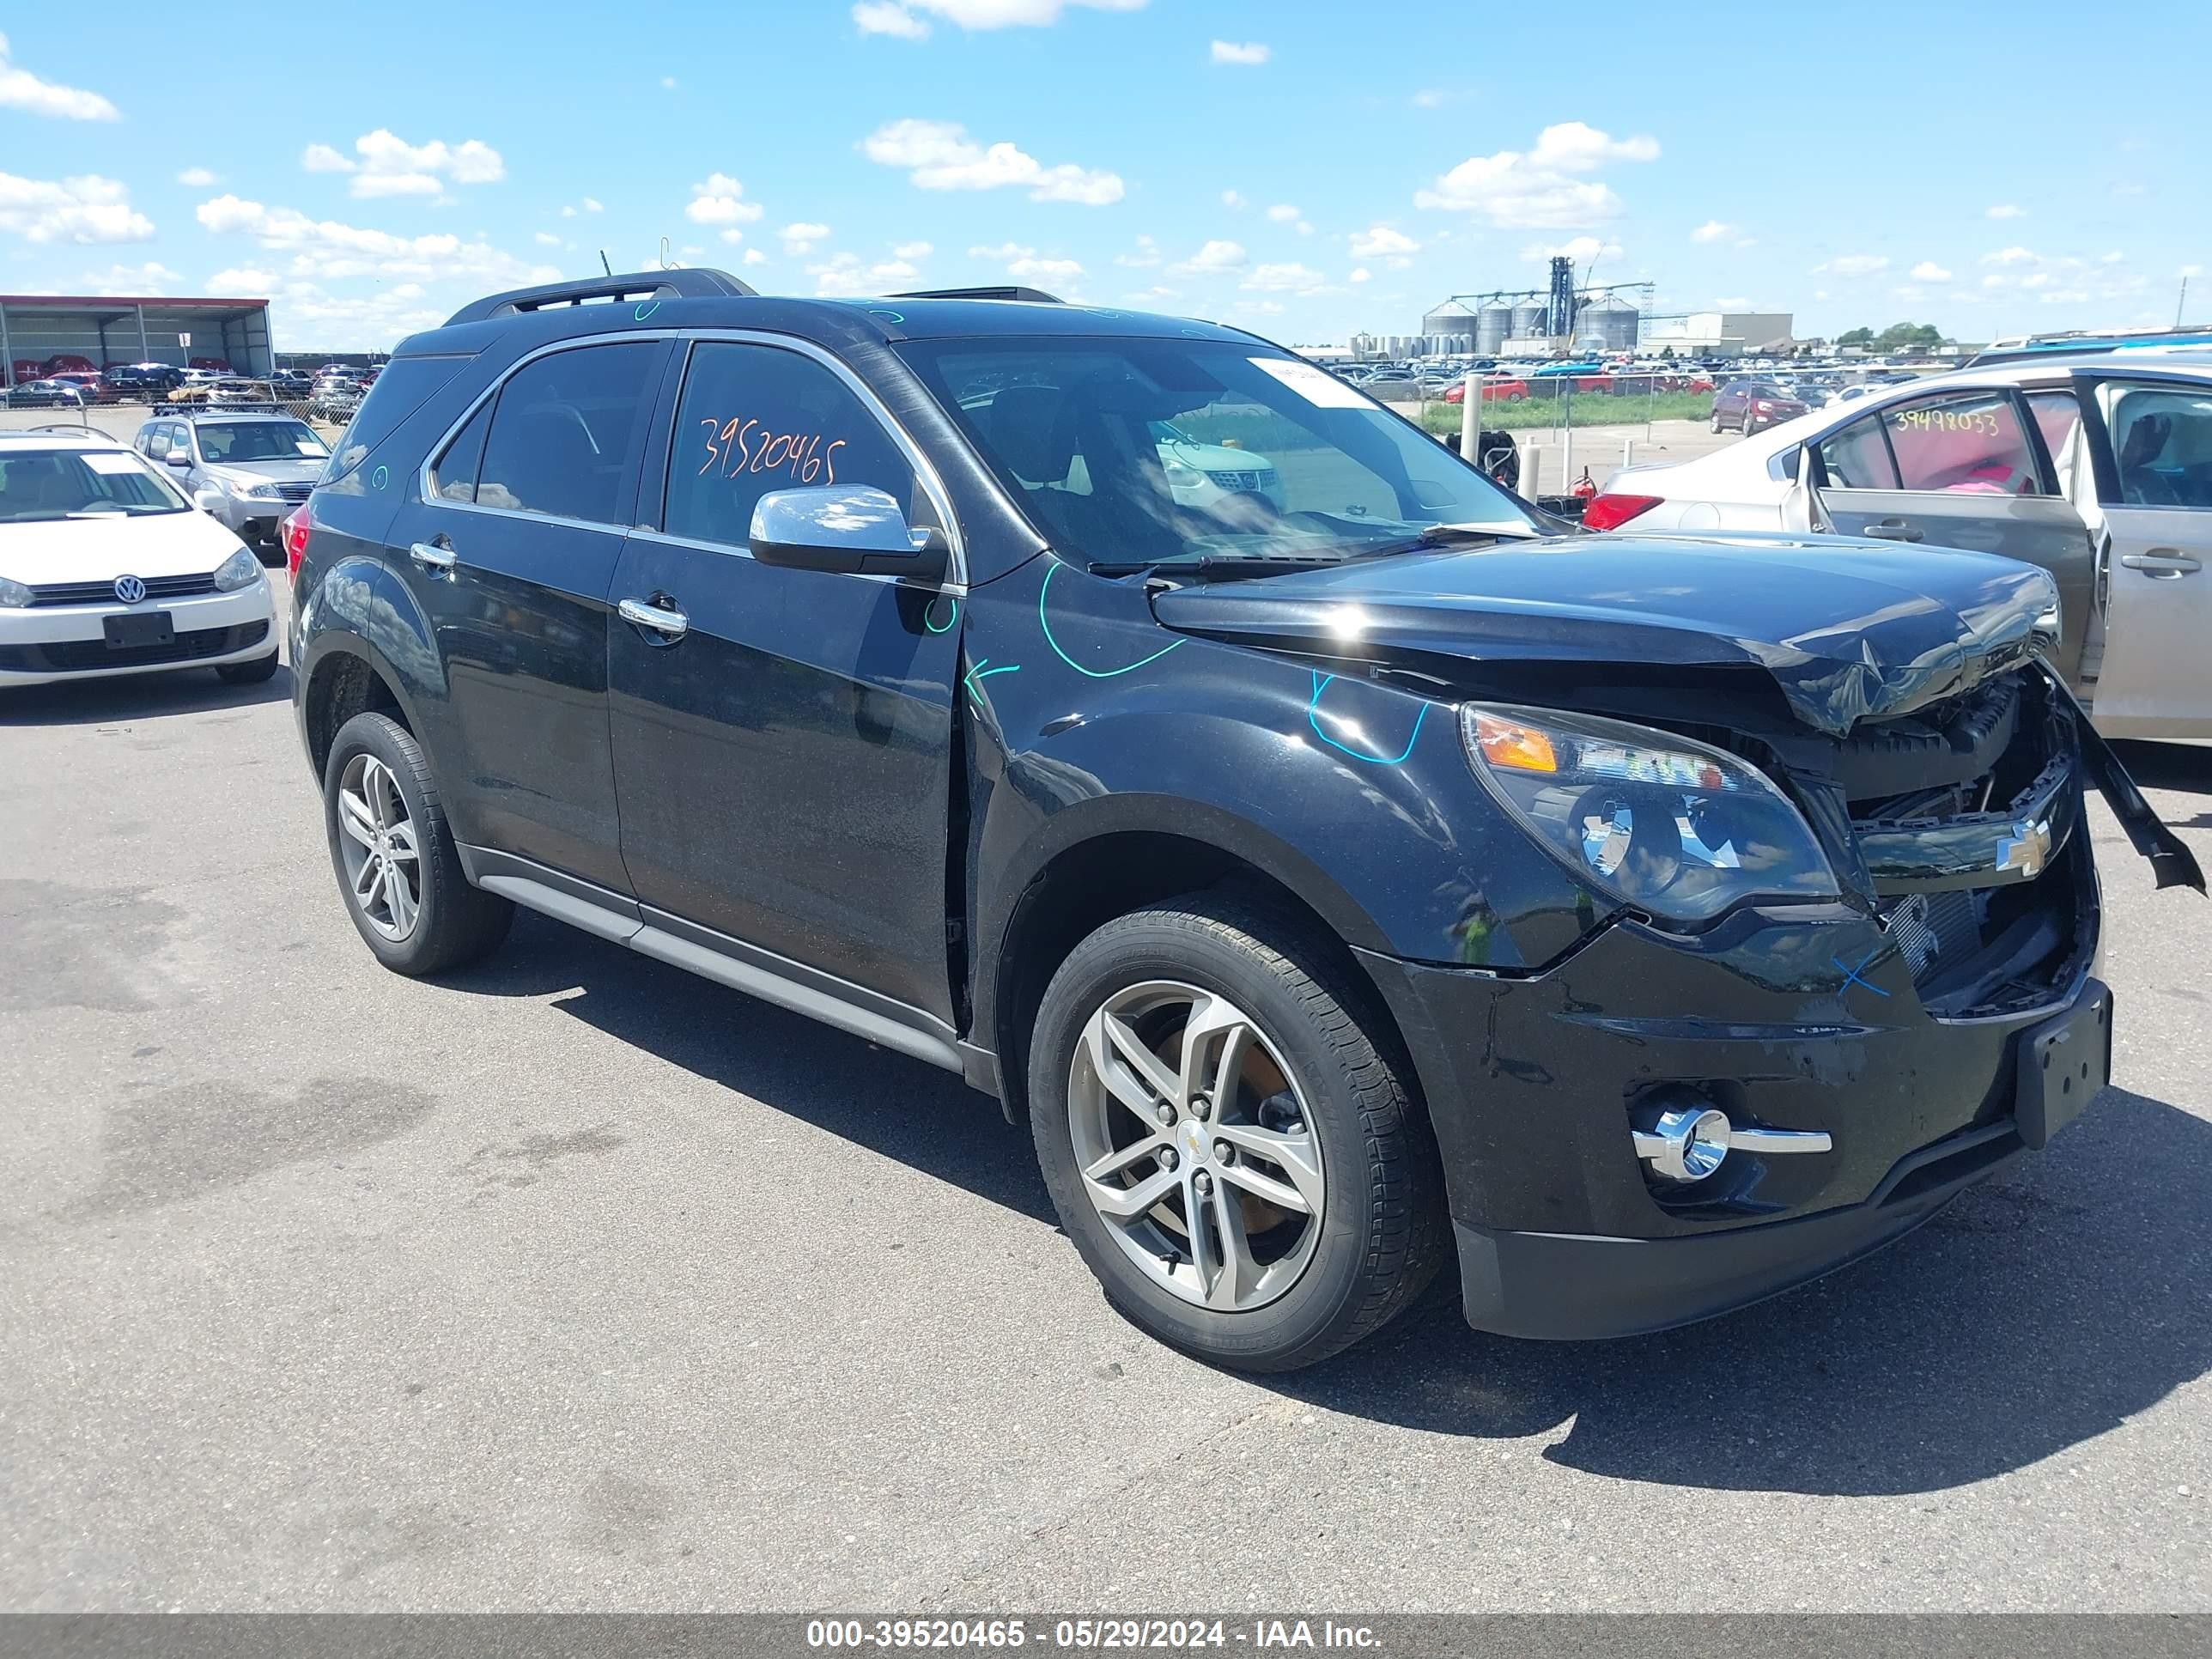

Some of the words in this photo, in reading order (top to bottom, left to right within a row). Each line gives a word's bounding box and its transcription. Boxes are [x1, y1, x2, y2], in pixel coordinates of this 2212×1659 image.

[1894, 410, 1999, 437] 39498033
[697, 417, 846, 486] 39520465
[117, 576, 144, 602] VW
